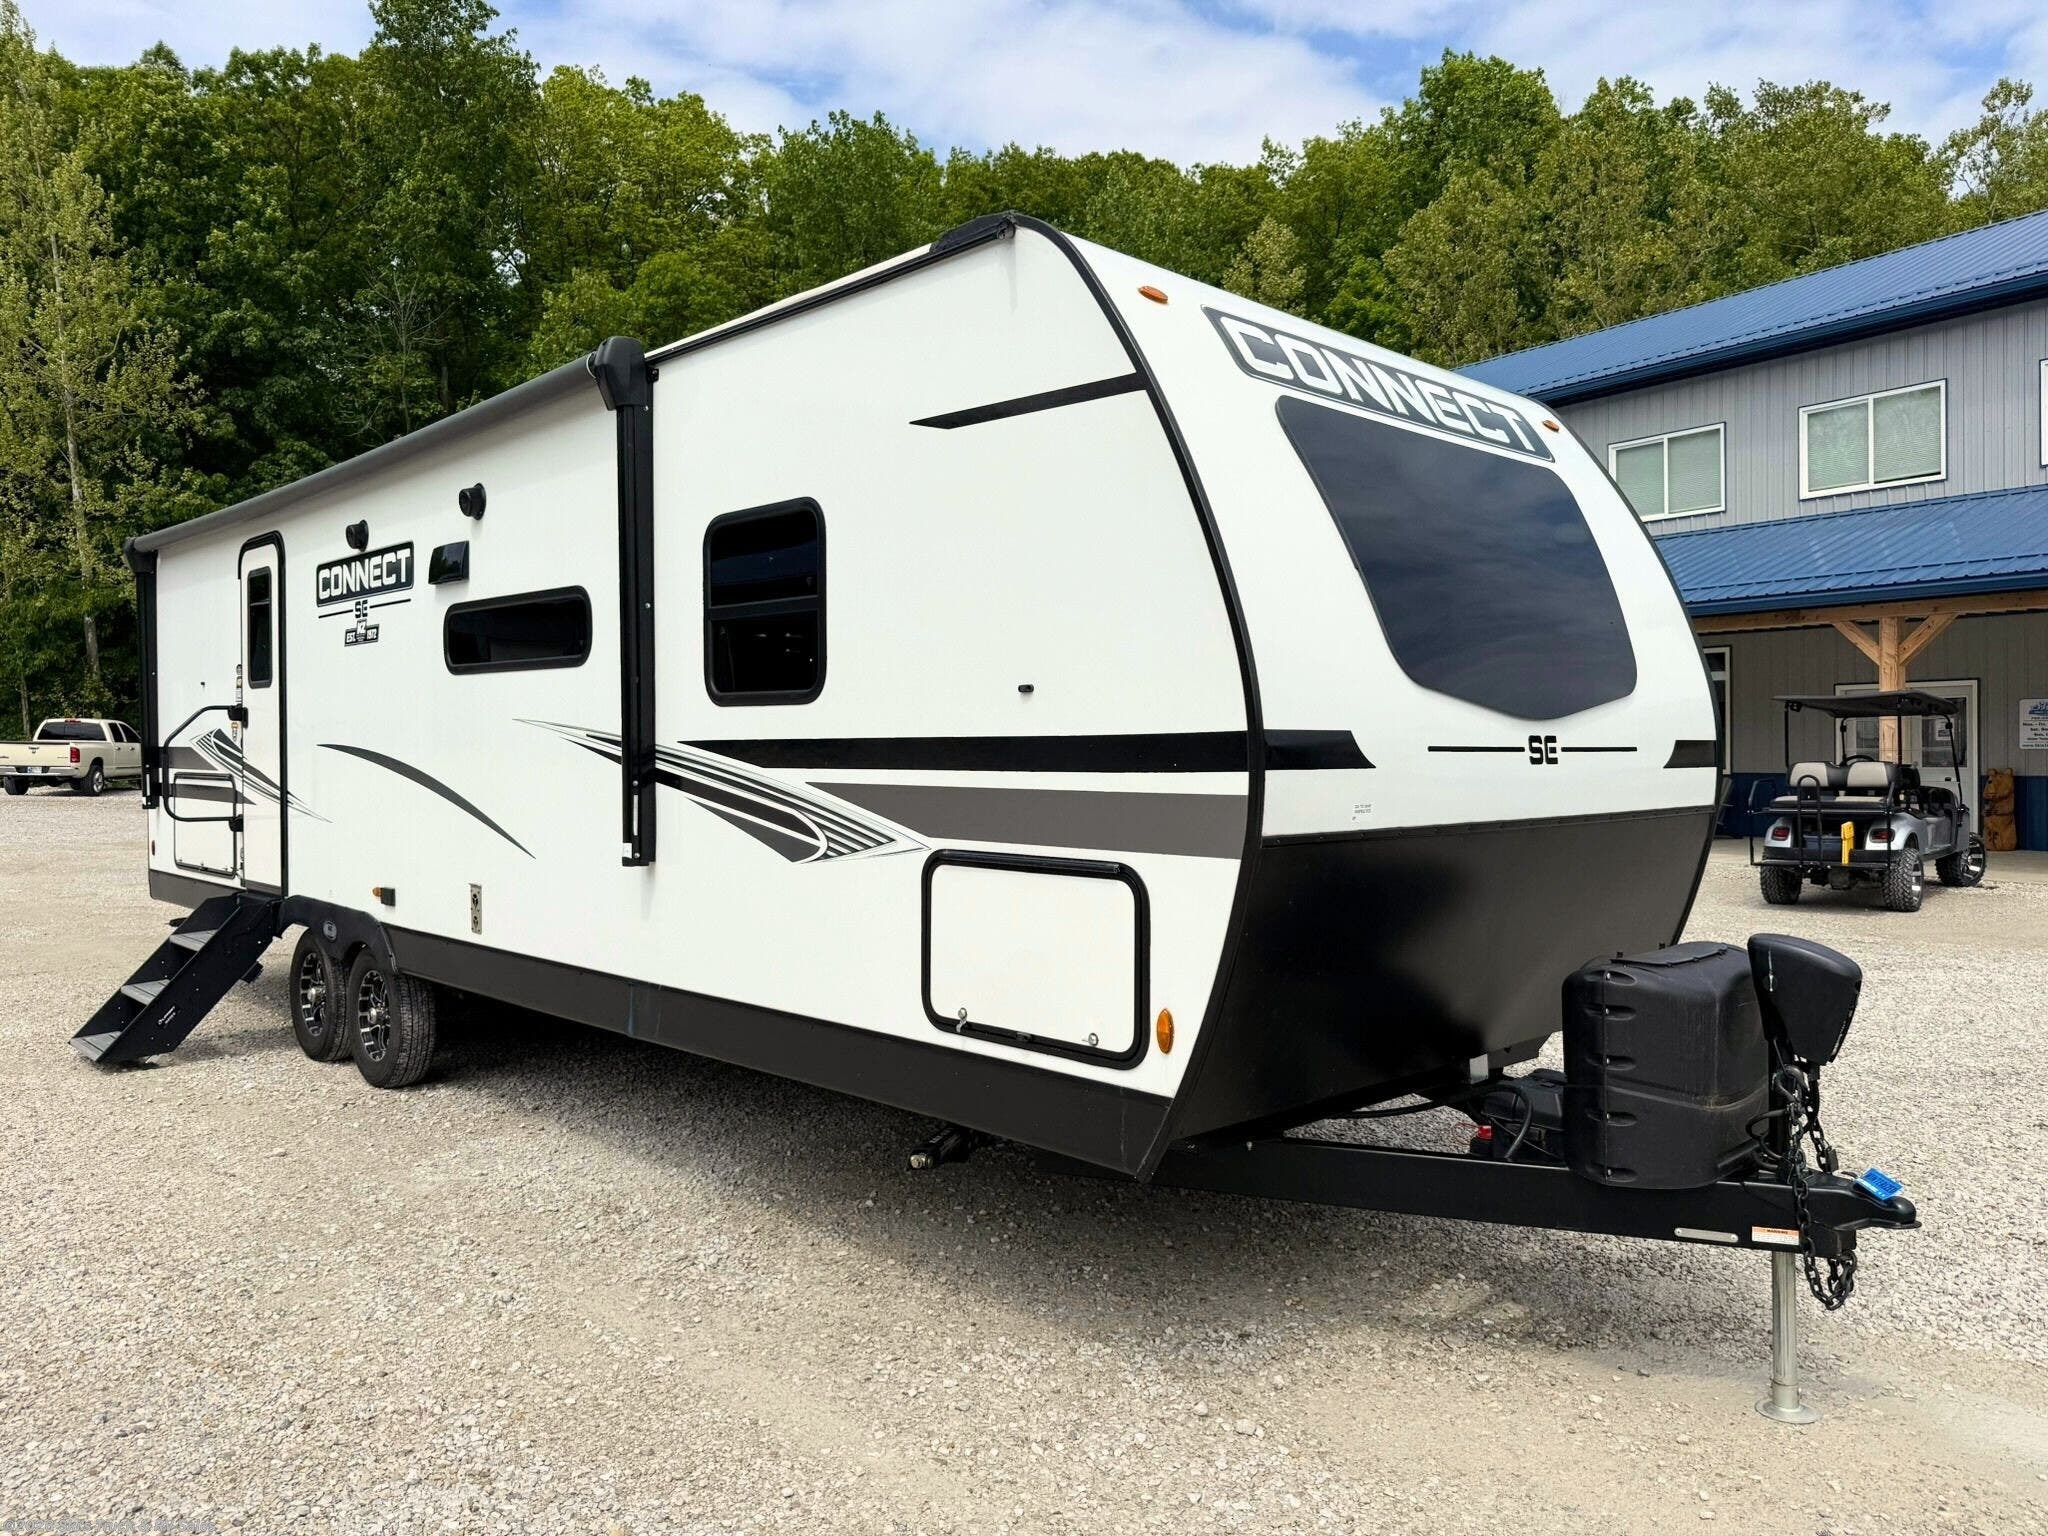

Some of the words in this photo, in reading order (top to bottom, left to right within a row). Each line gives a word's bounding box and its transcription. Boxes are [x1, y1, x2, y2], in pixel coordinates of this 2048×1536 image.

[1219, 316, 1536, 452] CONNECT
[318, 548, 411, 600] CONNECT
[355, 599, 368, 618] SE
[1528, 735, 1558, 765] SE
